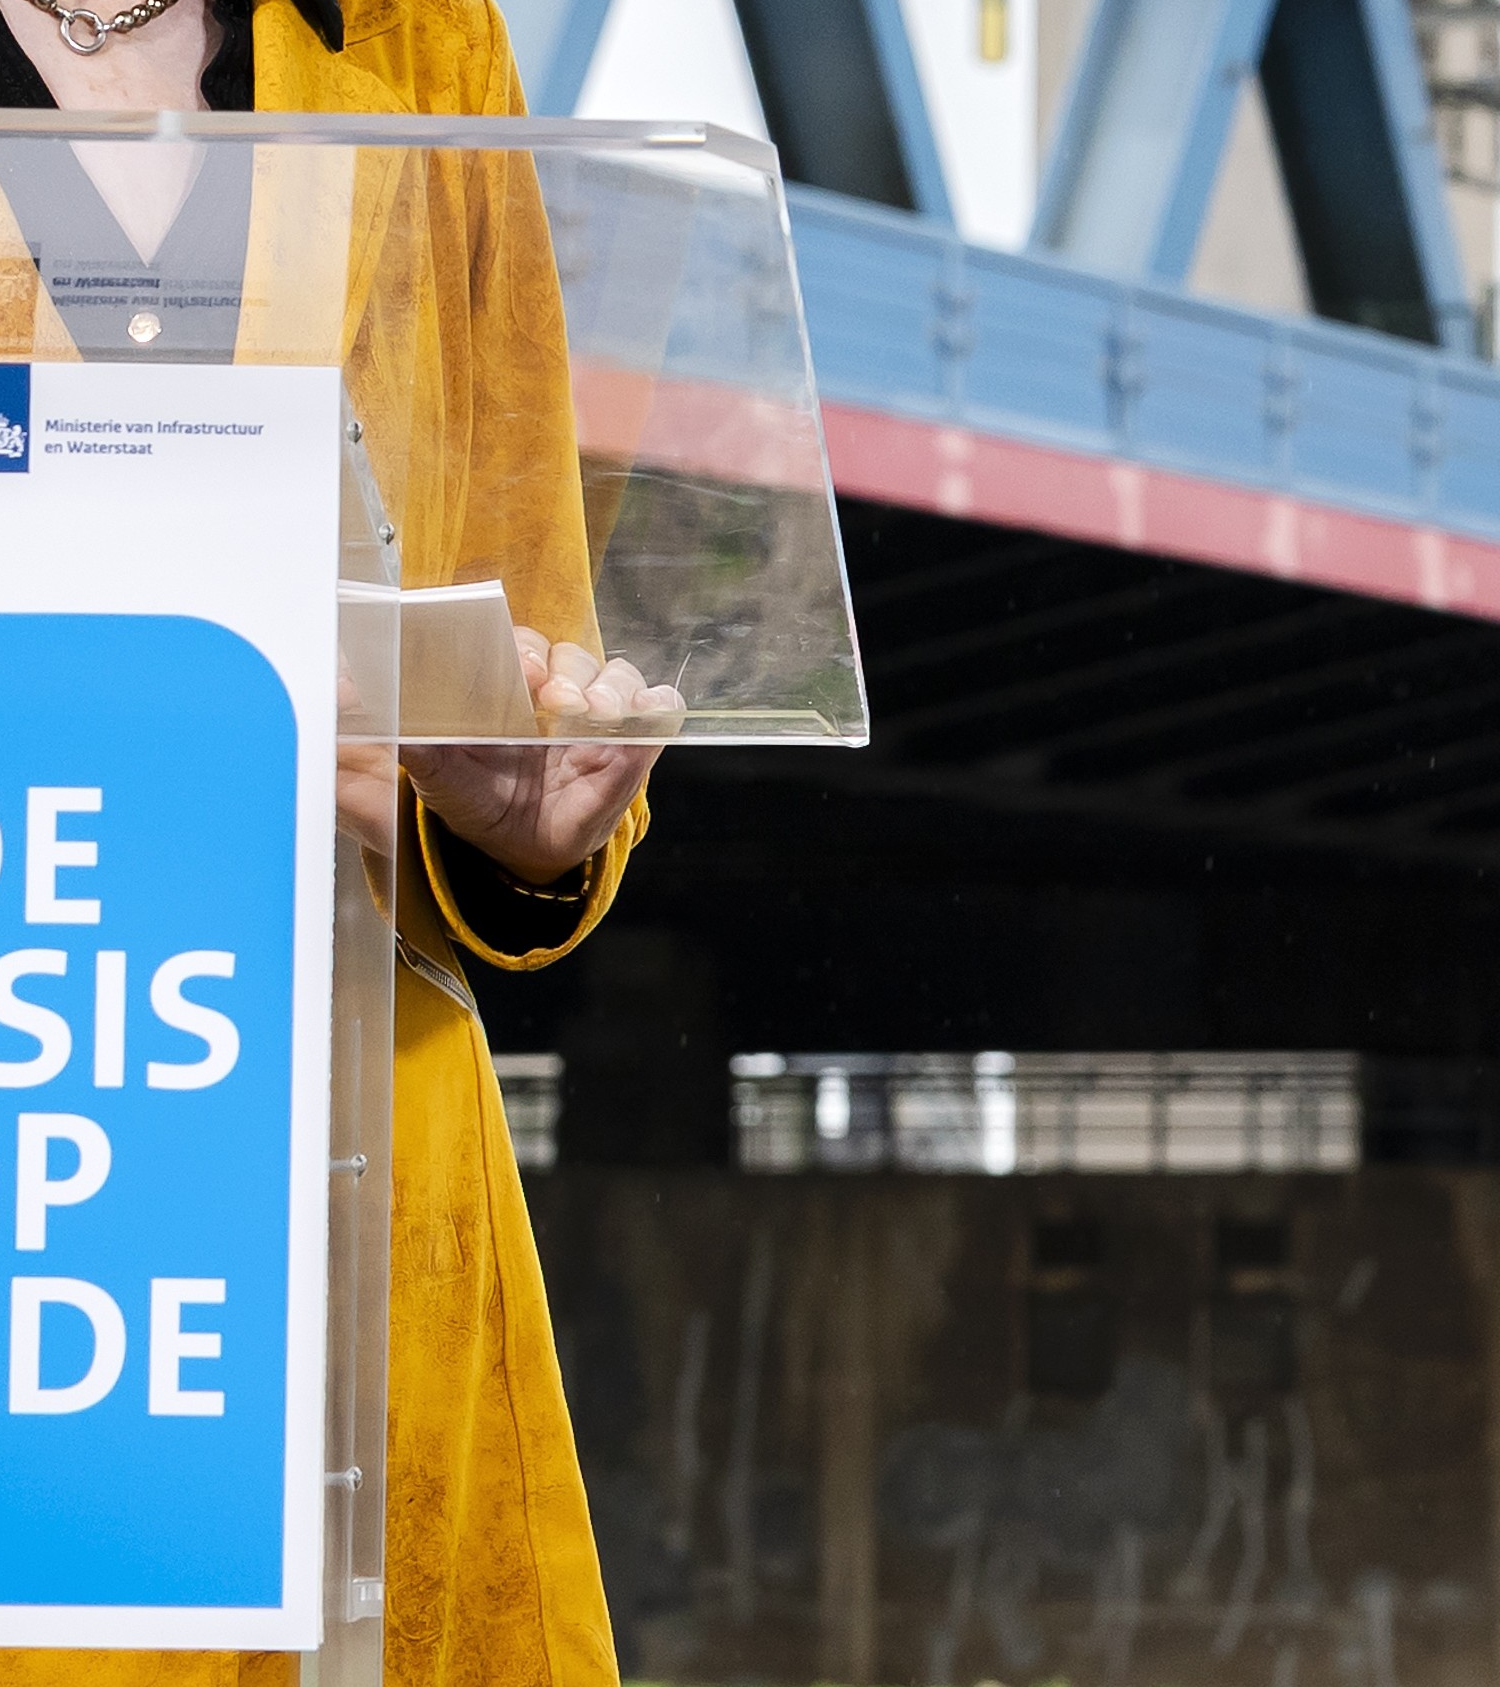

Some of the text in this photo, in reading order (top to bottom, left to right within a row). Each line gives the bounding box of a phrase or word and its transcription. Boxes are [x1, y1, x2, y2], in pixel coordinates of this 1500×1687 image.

[45, 419, 264, 436] Ministerie van Infrastructuur
[45, 440, 153, 455] en Waterstaat
